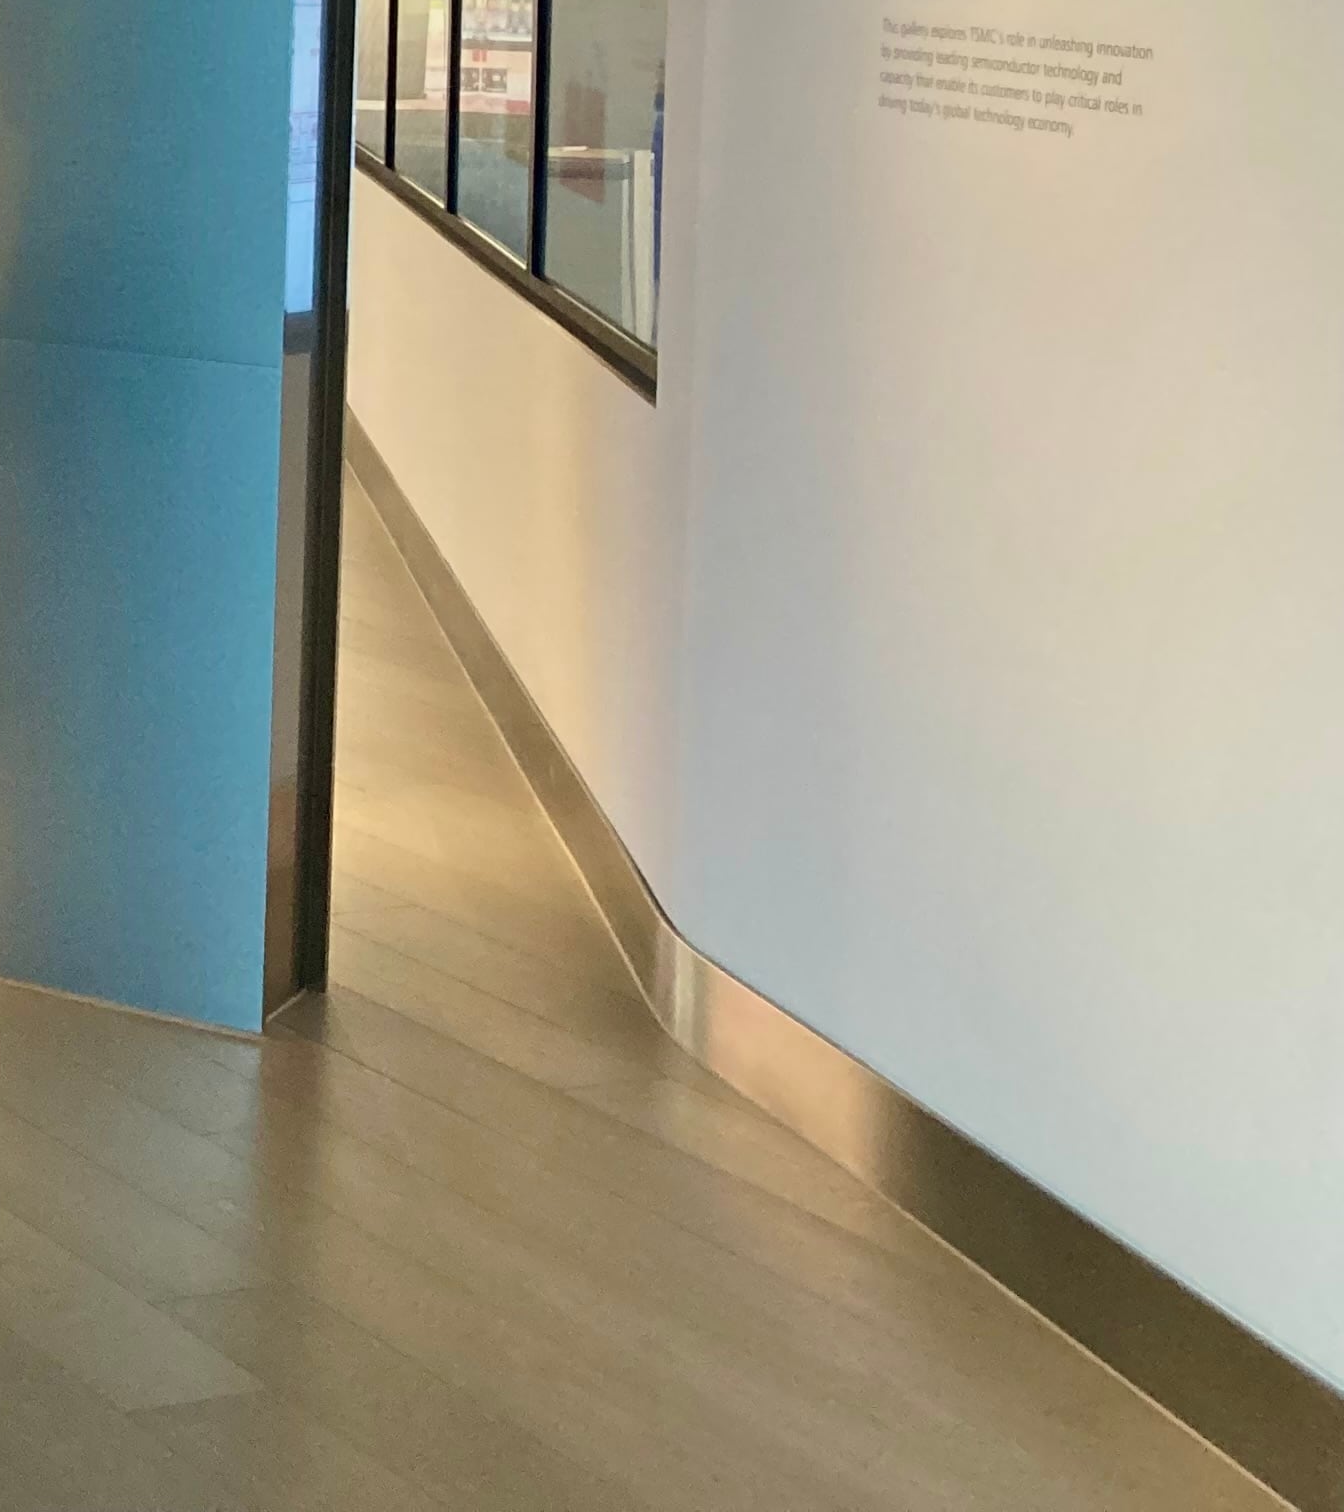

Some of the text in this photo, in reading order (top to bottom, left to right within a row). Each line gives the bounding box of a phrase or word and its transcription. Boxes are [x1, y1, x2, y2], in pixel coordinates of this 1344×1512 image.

[1039, 34, 1093, 58] unleashing
[1096, 41, 1154, 60] innovation
[1043, 62, 1099, 86] technology
[1102, 65, 1123, 86] and
[1032, 89, 1042, 103] to
[1044, 90, 1065, 110] play
[1068, 94, 1101, 111] critical
[1104, 97, 1129, 115] roles
[1132, 102, 1143, 117] in
[973, 107, 1024, 131] technology
